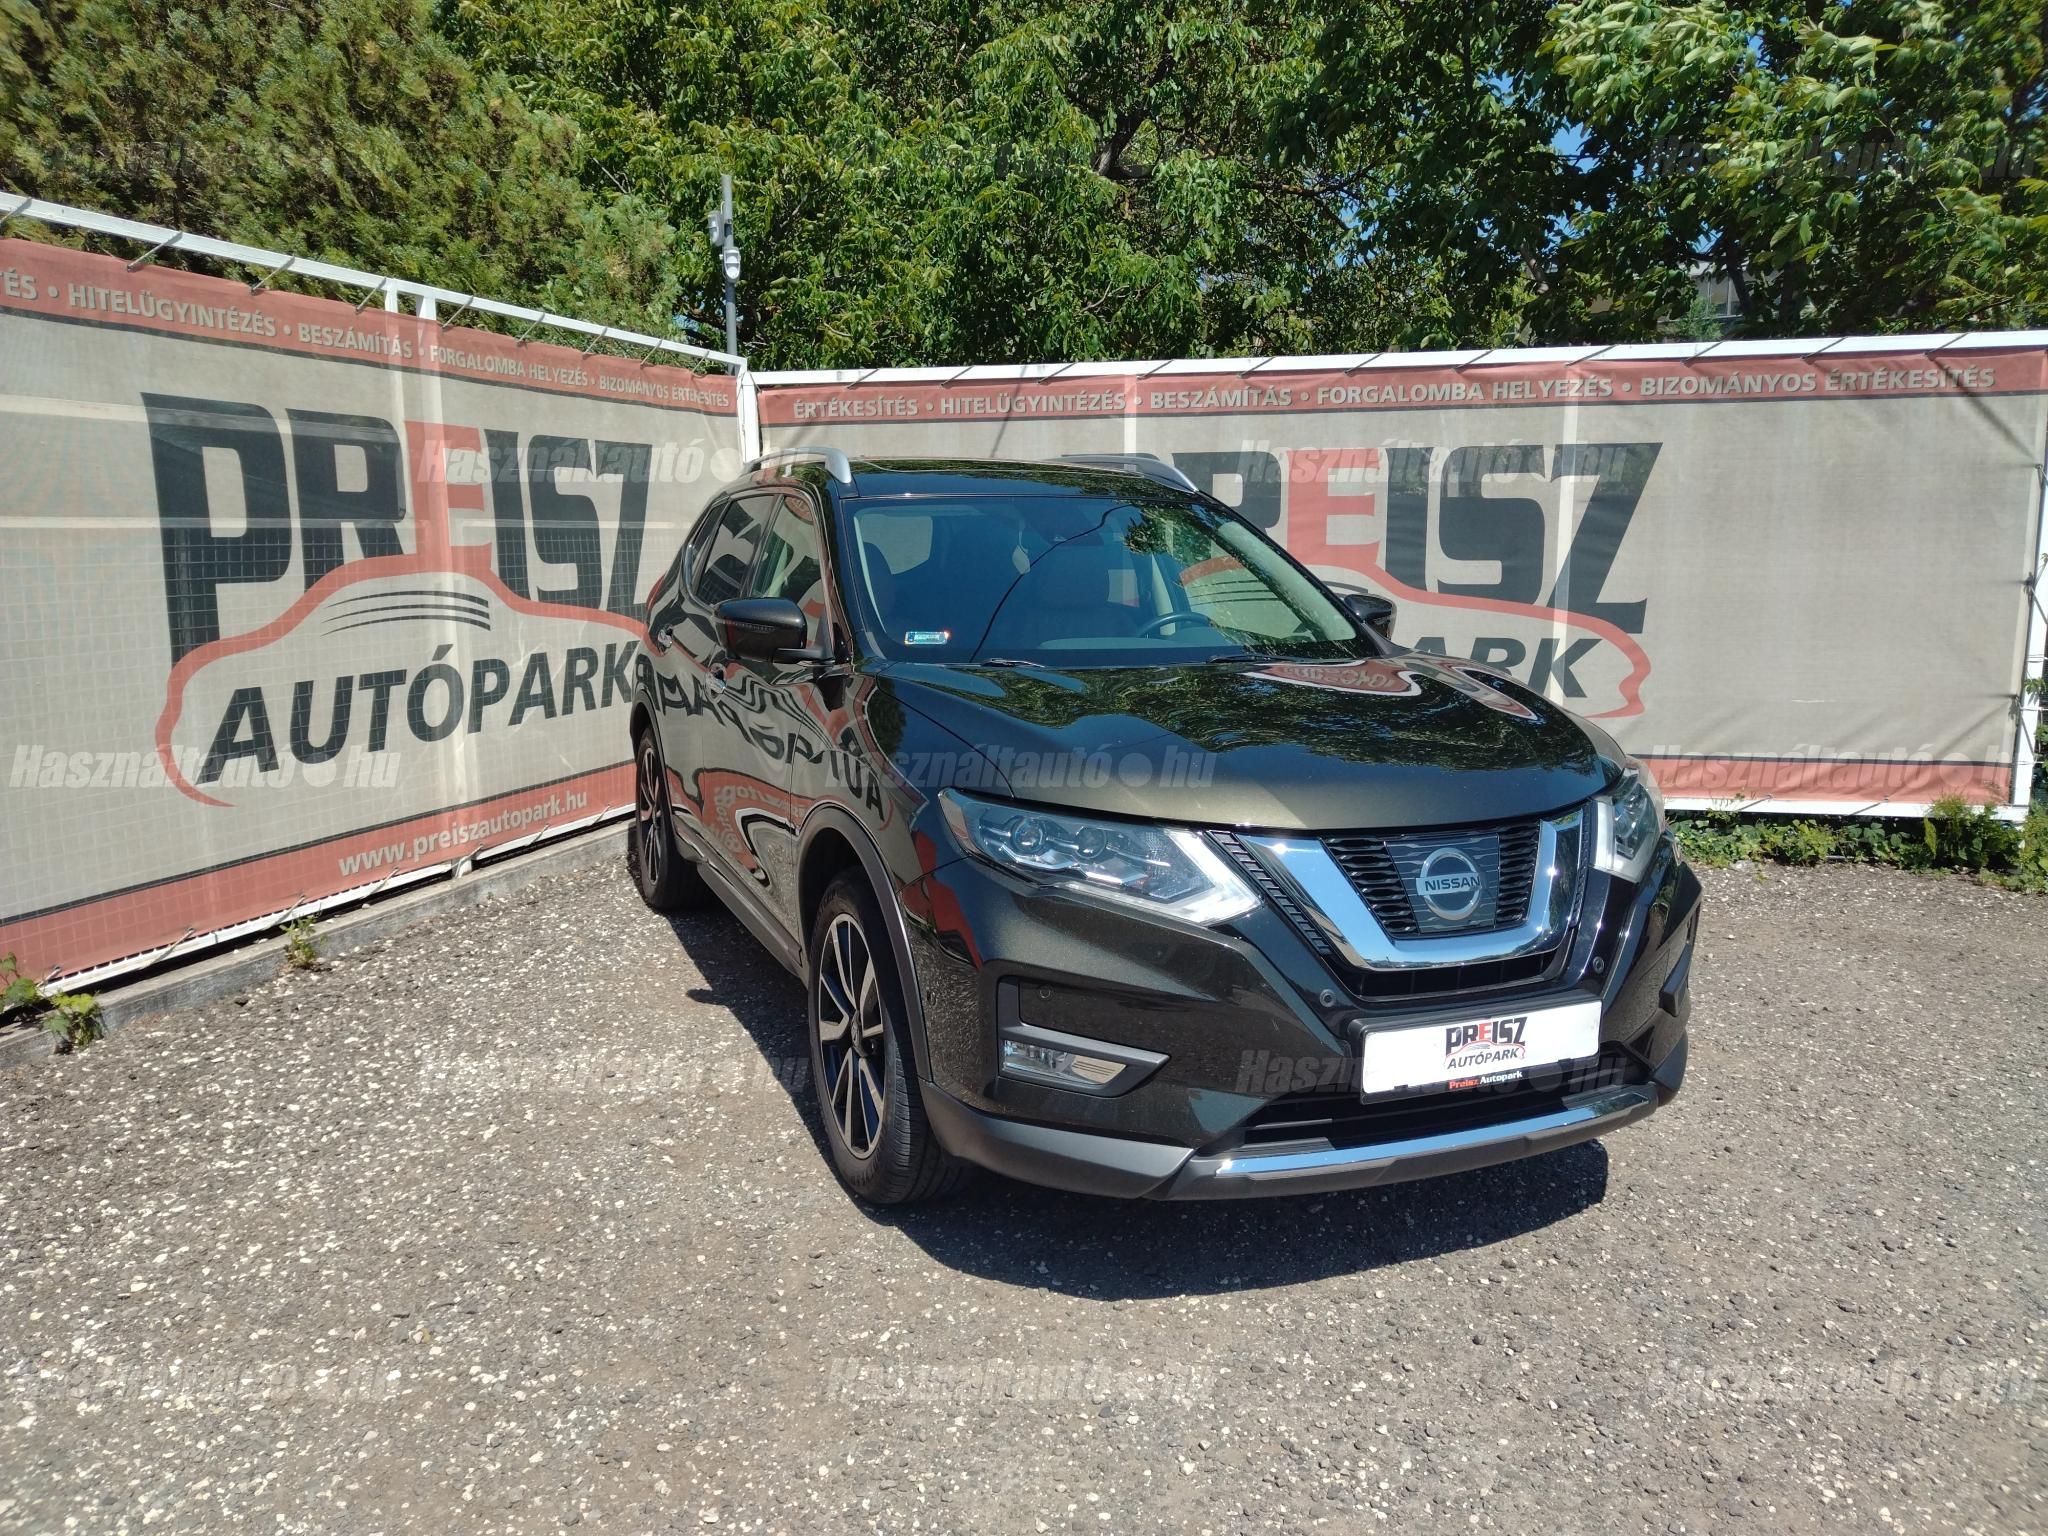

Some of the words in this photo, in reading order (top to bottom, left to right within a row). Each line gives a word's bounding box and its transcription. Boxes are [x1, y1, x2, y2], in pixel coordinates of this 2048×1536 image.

[0, 267, 38, 300] ÉS
[68, 282, 277, 337] HITELÜGYINTÉZÉS
[298, 323, 413, 360] BESZÁMÍTÁS
[430, 344, 526, 377] FORGALOMBA
[528, 365, 588, 386] HELYEZÉS
[599, 374, 669, 399] BIZOMÁNYOS
[793, 392, 918, 419] ÉRTÉKESÍTÉS
[940, 388, 1126, 415] HITELÜGYINTÉZÉS
[1150, 384, 1292, 410] BESZÁMÍTÁS
[1317, 382, 1484, 405] FORGALOMBA
[1492, 375, 1613, 399] HELYEZÉS
[1640, 371, 1816, 396] BIZOMÁNYOS
[1824, 364, 1996, 391] ÉRTÉKESÍTÉS
[141, 392, 653, 668] PREISZ
[1061, 441, 1663, 634] REISZ
[195, 641, 641, 785] AUTÓPARK
[339, 789, 588, 877] www.preiszautopark.hu
[1424, 876, 1481, 891] NISSAN
[1446, 1017, 1527, 1057] PREISZ
[1447, 1048, 1519, 1070] AUTÓPARK
[1449, 1079, 1480, 1090] Preisz
[1480, 1070, 1523, 1085] Autopark
